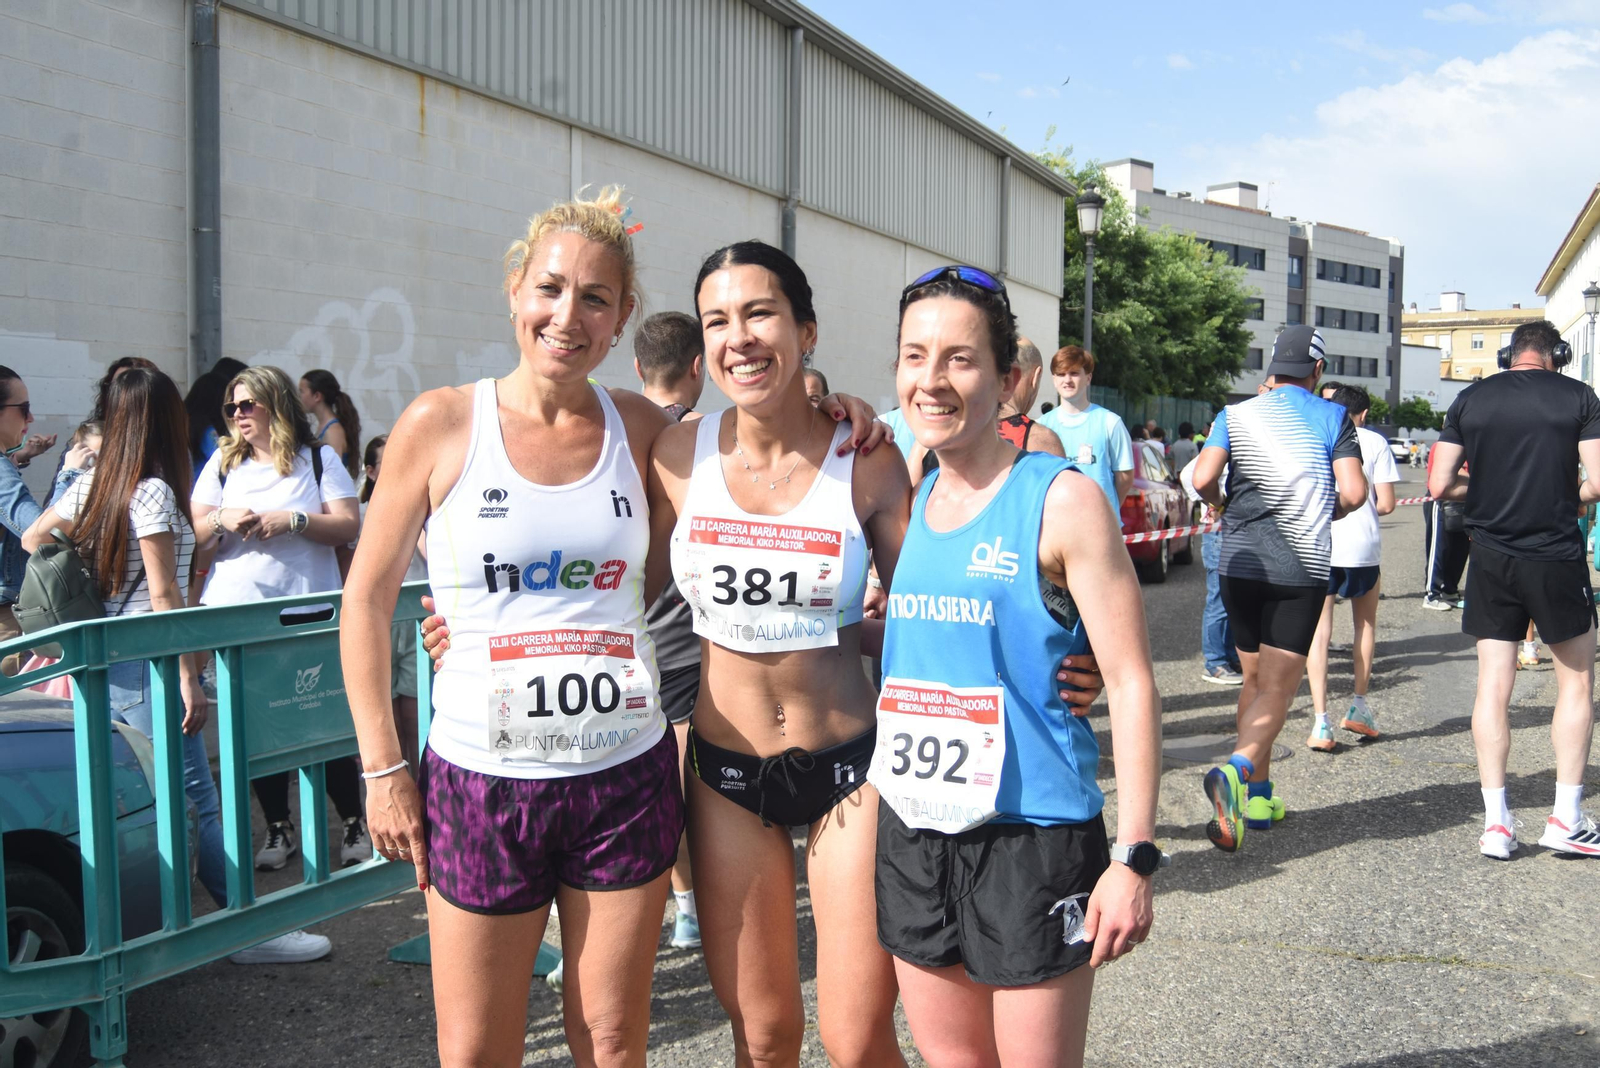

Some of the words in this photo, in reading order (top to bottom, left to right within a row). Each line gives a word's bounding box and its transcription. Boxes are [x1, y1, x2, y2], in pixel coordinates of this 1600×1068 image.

[707, 521, 748, 535] CARRERA
[750, 525, 777, 538] MARÍA
[717, 534, 755, 546] MEMORIAL
[756, 538, 775, 548] KIKO
[483, 550, 627, 593] indea
[966, 571, 988, 579] sport
[993, 574, 1015, 583] shop
[712, 565, 803, 607] 381
[510, 633, 553, 647] CARRERA
[555, 630, 582, 643] MARÍA
[524, 645, 562, 655] MEMORIAL
[564, 643, 581, 653] KIKO
[291, 693, 317, 704] Municipal
[527, 672, 621, 717] 100
[892, 689, 919, 702] CARRERA
[920, 691, 944, 704] MARÍA
[897, 702, 927, 713] MEMORIAL
[928, 705, 943, 715] KIKO
[892, 732, 969, 784] 392
